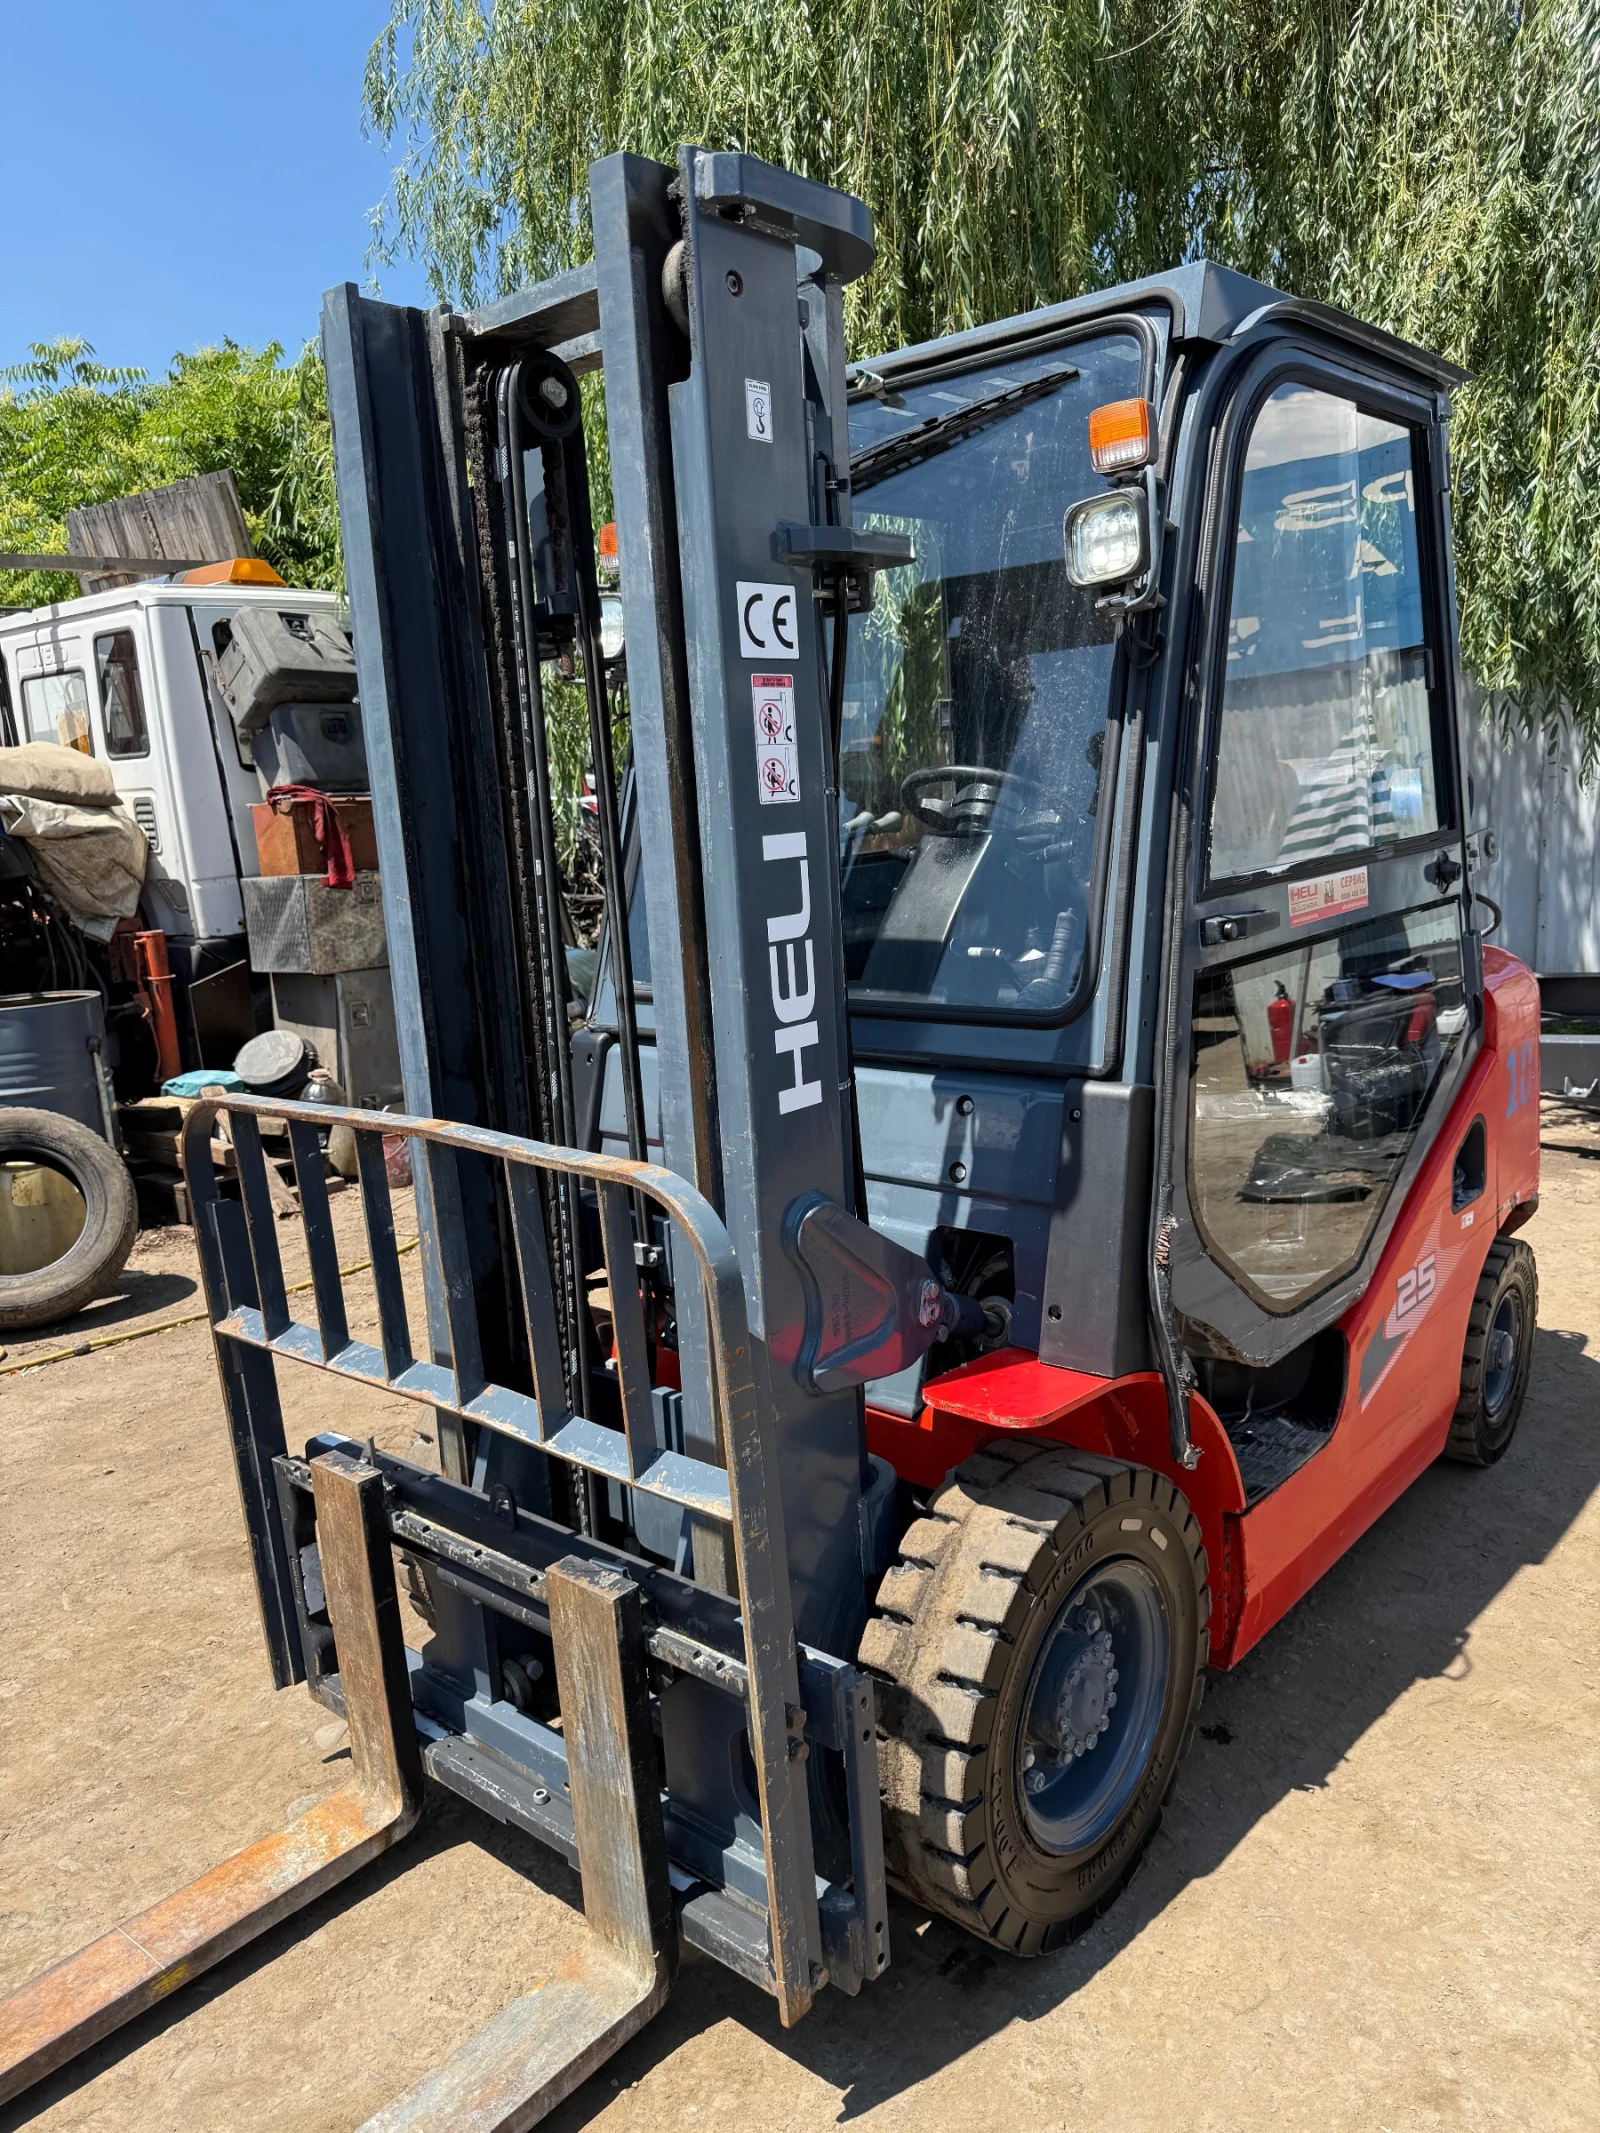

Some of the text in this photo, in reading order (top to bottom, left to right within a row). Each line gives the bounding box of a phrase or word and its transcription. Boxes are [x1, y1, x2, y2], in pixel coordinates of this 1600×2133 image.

[744, 593, 793, 649] CE
[1290, 884, 1318, 901] HELI
[1291, 901, 1318, 913] BULGARIA
[1340, 872, 1366, 888] СЕРВИЗ
[762, 832, 822, 1115] HELI
[1506, 1038, 1532, 1119] 10
[1396, 1251, 1436, 1320] 25
[991, 1767, 1018, 1878] 7.00-12
[1077, 1753, 1164, 1891] TRELLEBORG
